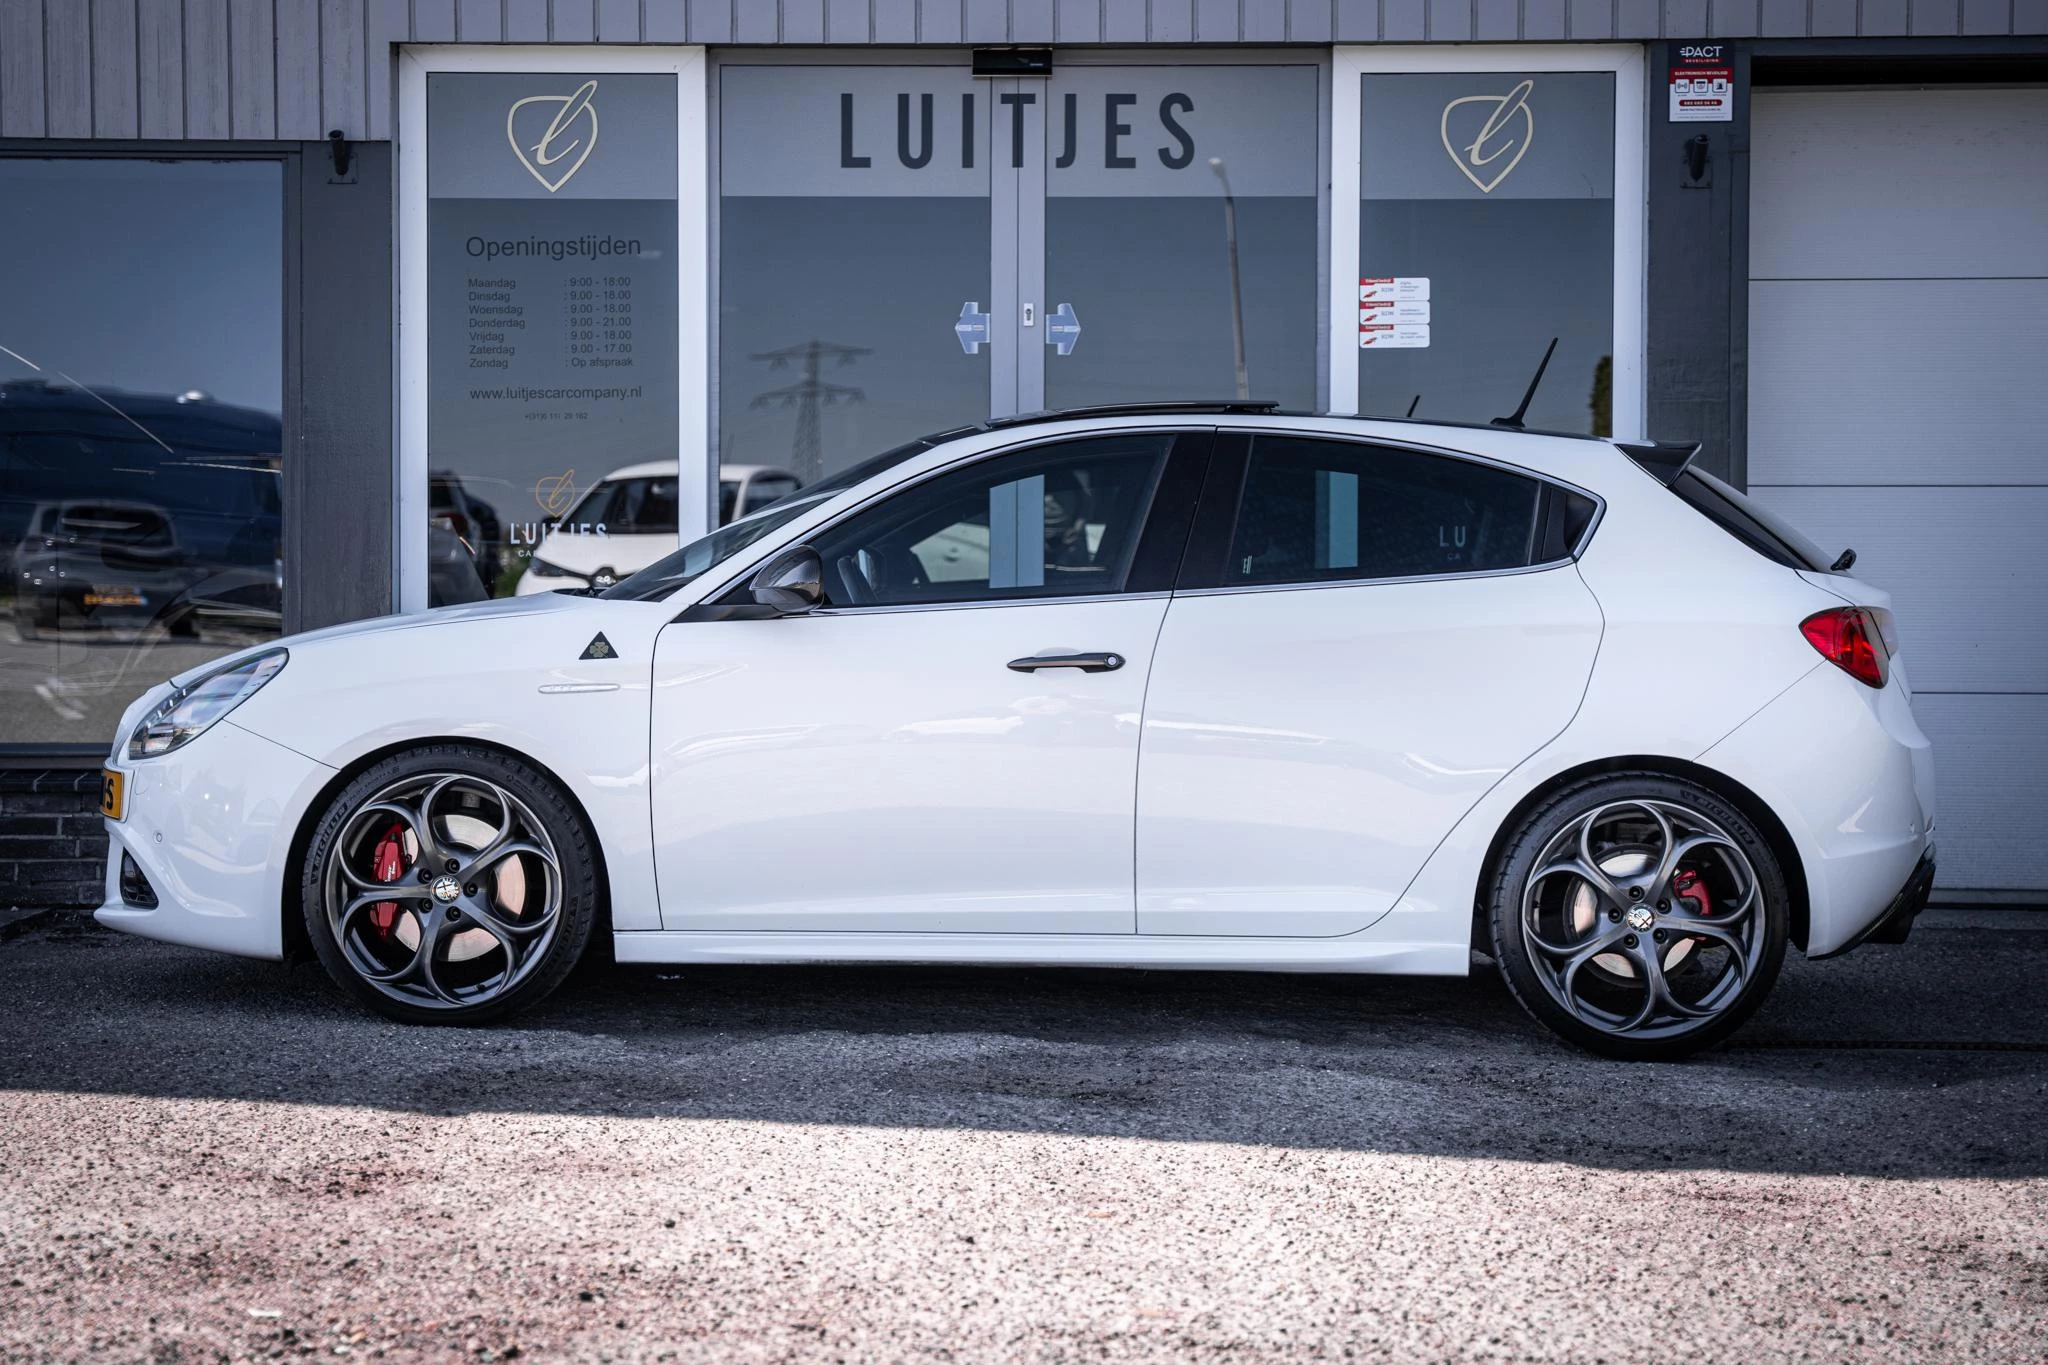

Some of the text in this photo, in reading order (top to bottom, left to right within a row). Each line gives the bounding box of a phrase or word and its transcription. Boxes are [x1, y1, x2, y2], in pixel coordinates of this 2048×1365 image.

[1686, 46, 1723, 57] PACT
[840, 92, 1196, 170] LUITJES
[466, 235, 641, 261] Openingstijden
[468, 278, 516, 289] Maandag
[468, 292, 511, 302] Dinsdag
[469, 305, 523, 316] Woensdag
[469, 318, 526, 329] Donderdag
[469, 332, 505, 343] Vrijdag
[469, 345, 516, 356] Zaterdag
[469, 358, 509, 369] Zondag
[572, 358, 587, 369] Op
[590, 357, 634, 369] afspraak
[470, 385, 642, 402] www.luitjescarcompany.nl
